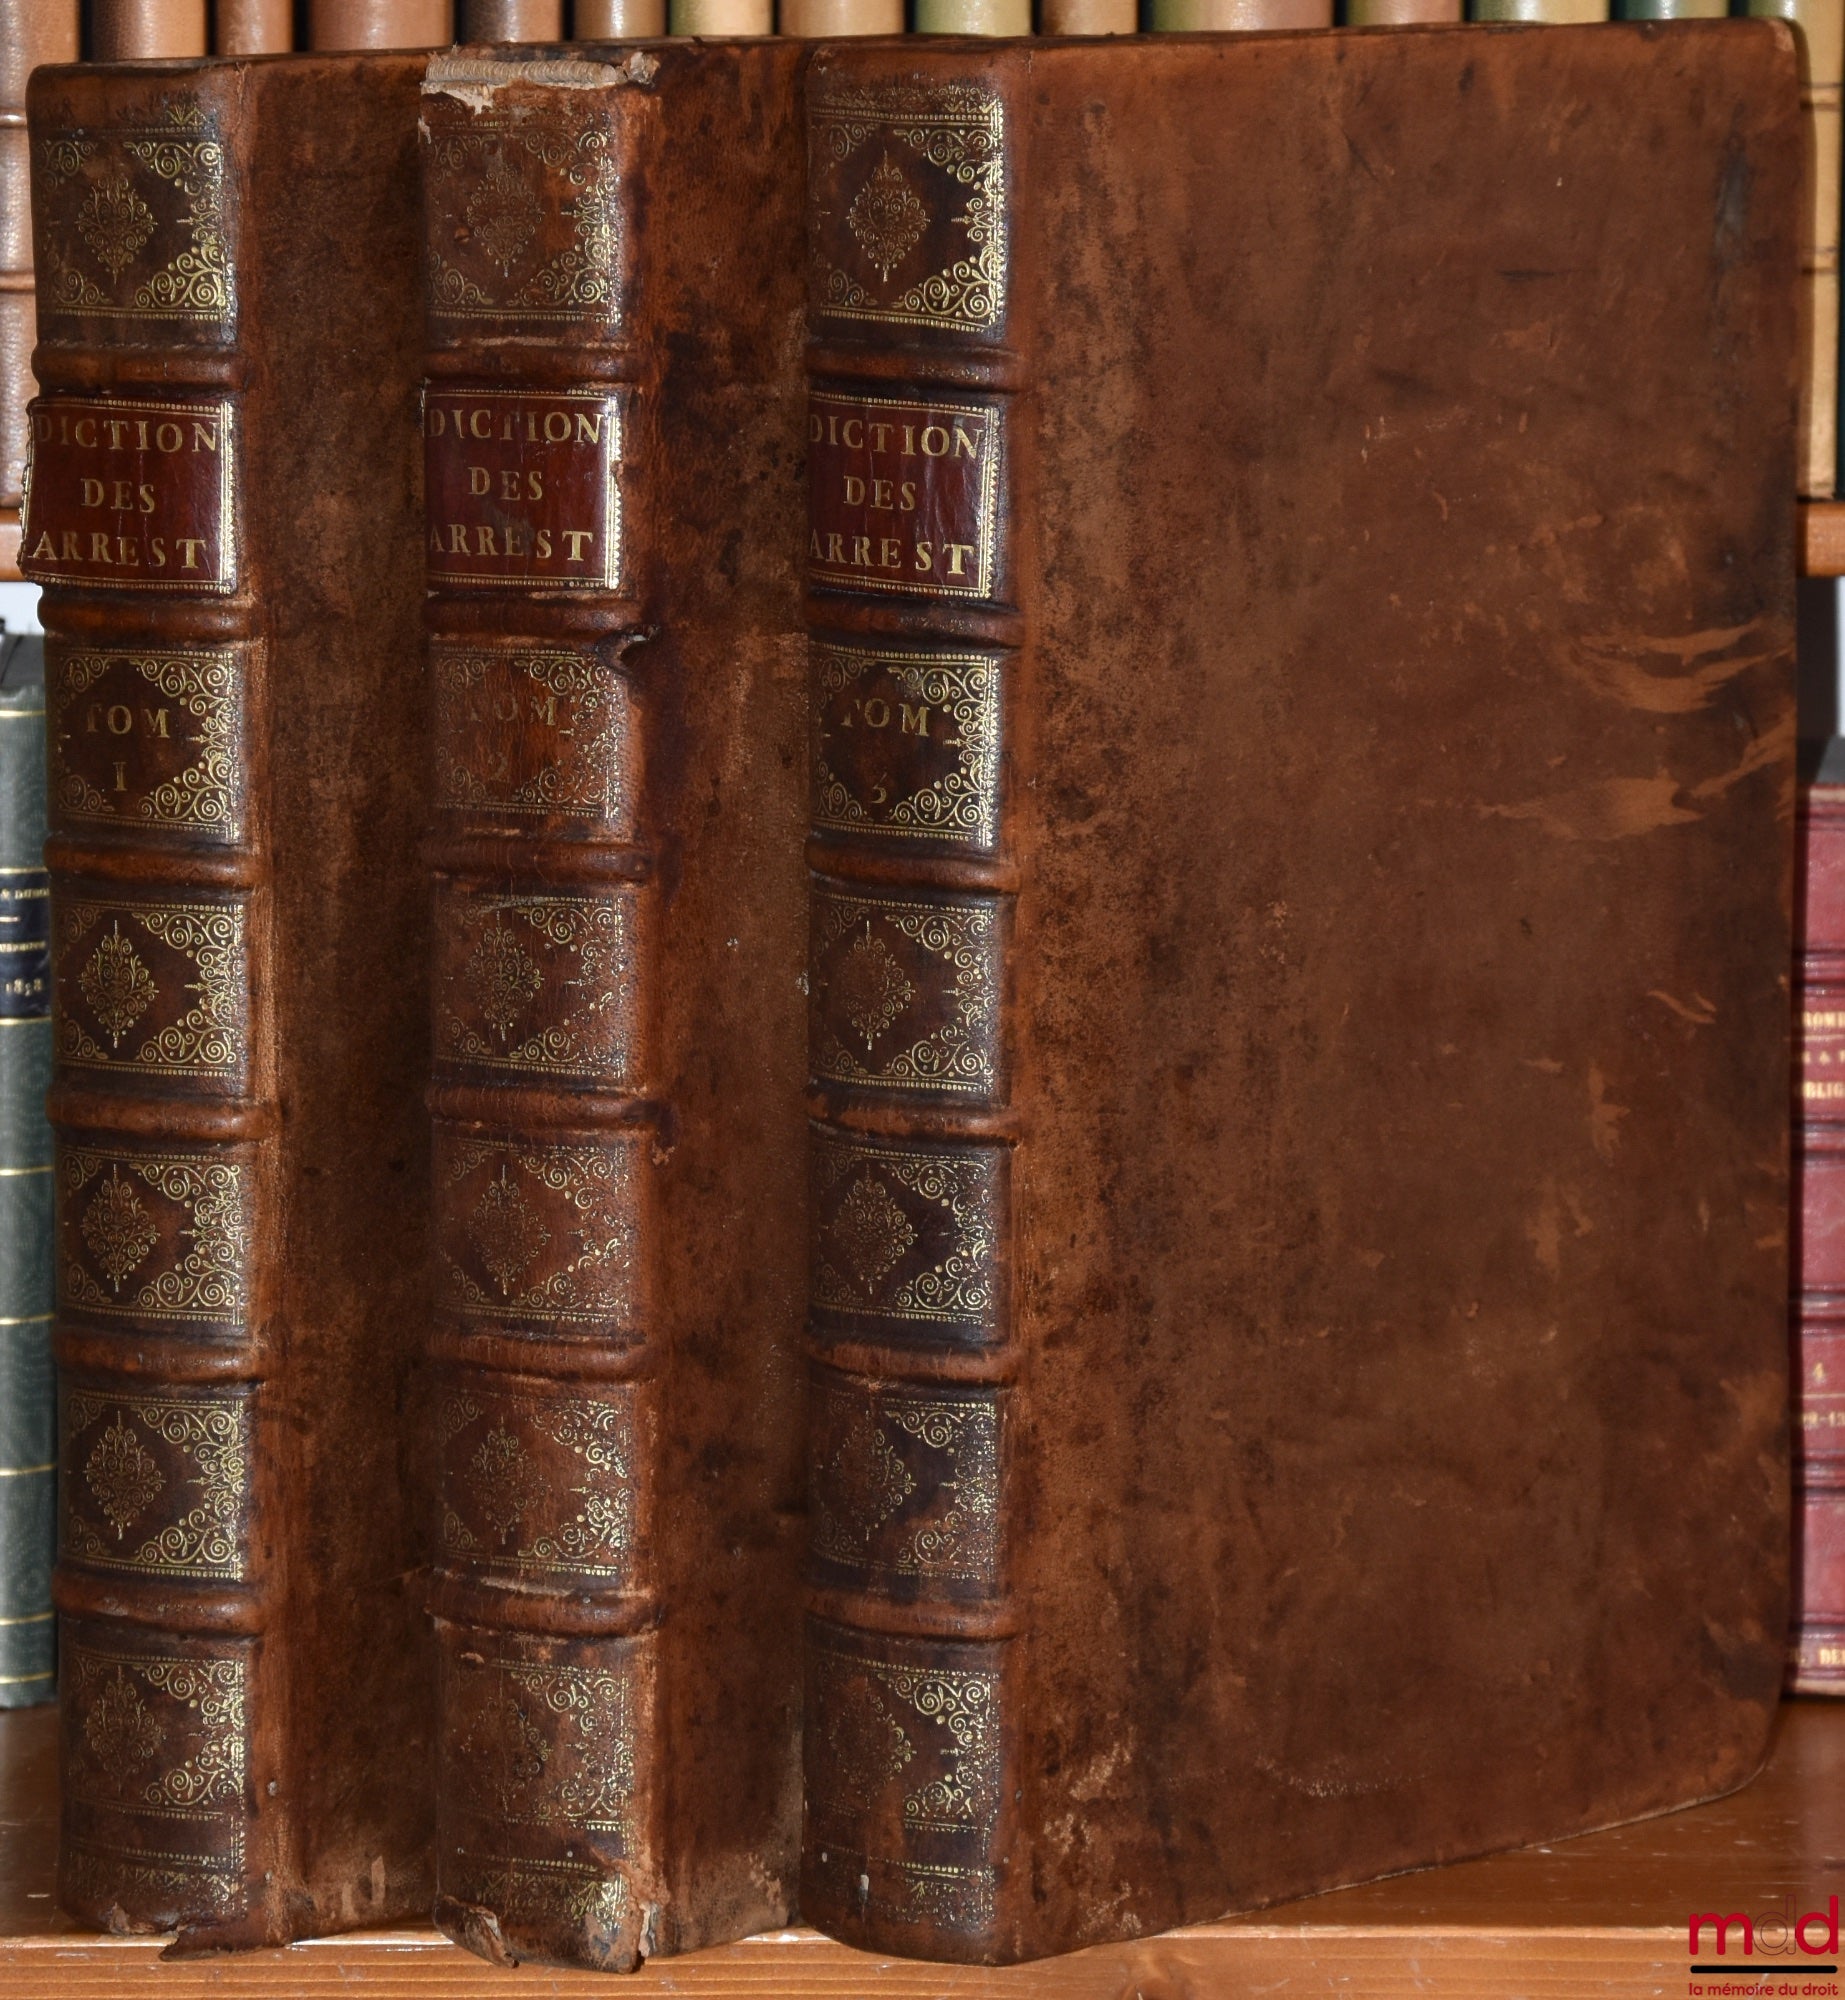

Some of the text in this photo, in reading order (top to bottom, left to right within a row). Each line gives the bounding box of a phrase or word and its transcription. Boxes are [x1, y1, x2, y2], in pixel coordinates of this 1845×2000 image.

[32, 413, 219, 453] DICTION
[428, 408, 605, 444] DICTION
[809, 413, 985, 459] DICTION
[80, 477, 155, 513] DES
[467, 466, 543, 501] DES
[843, 475, 916, 511] DES
[27, 530, 206, 569] ARREST
[429, 523, 594, 562] ARREST
[809, 528, 975, 575] ARREST
[85, 703, 170, 739] TOM
[469, 695, 557, 726] OM
